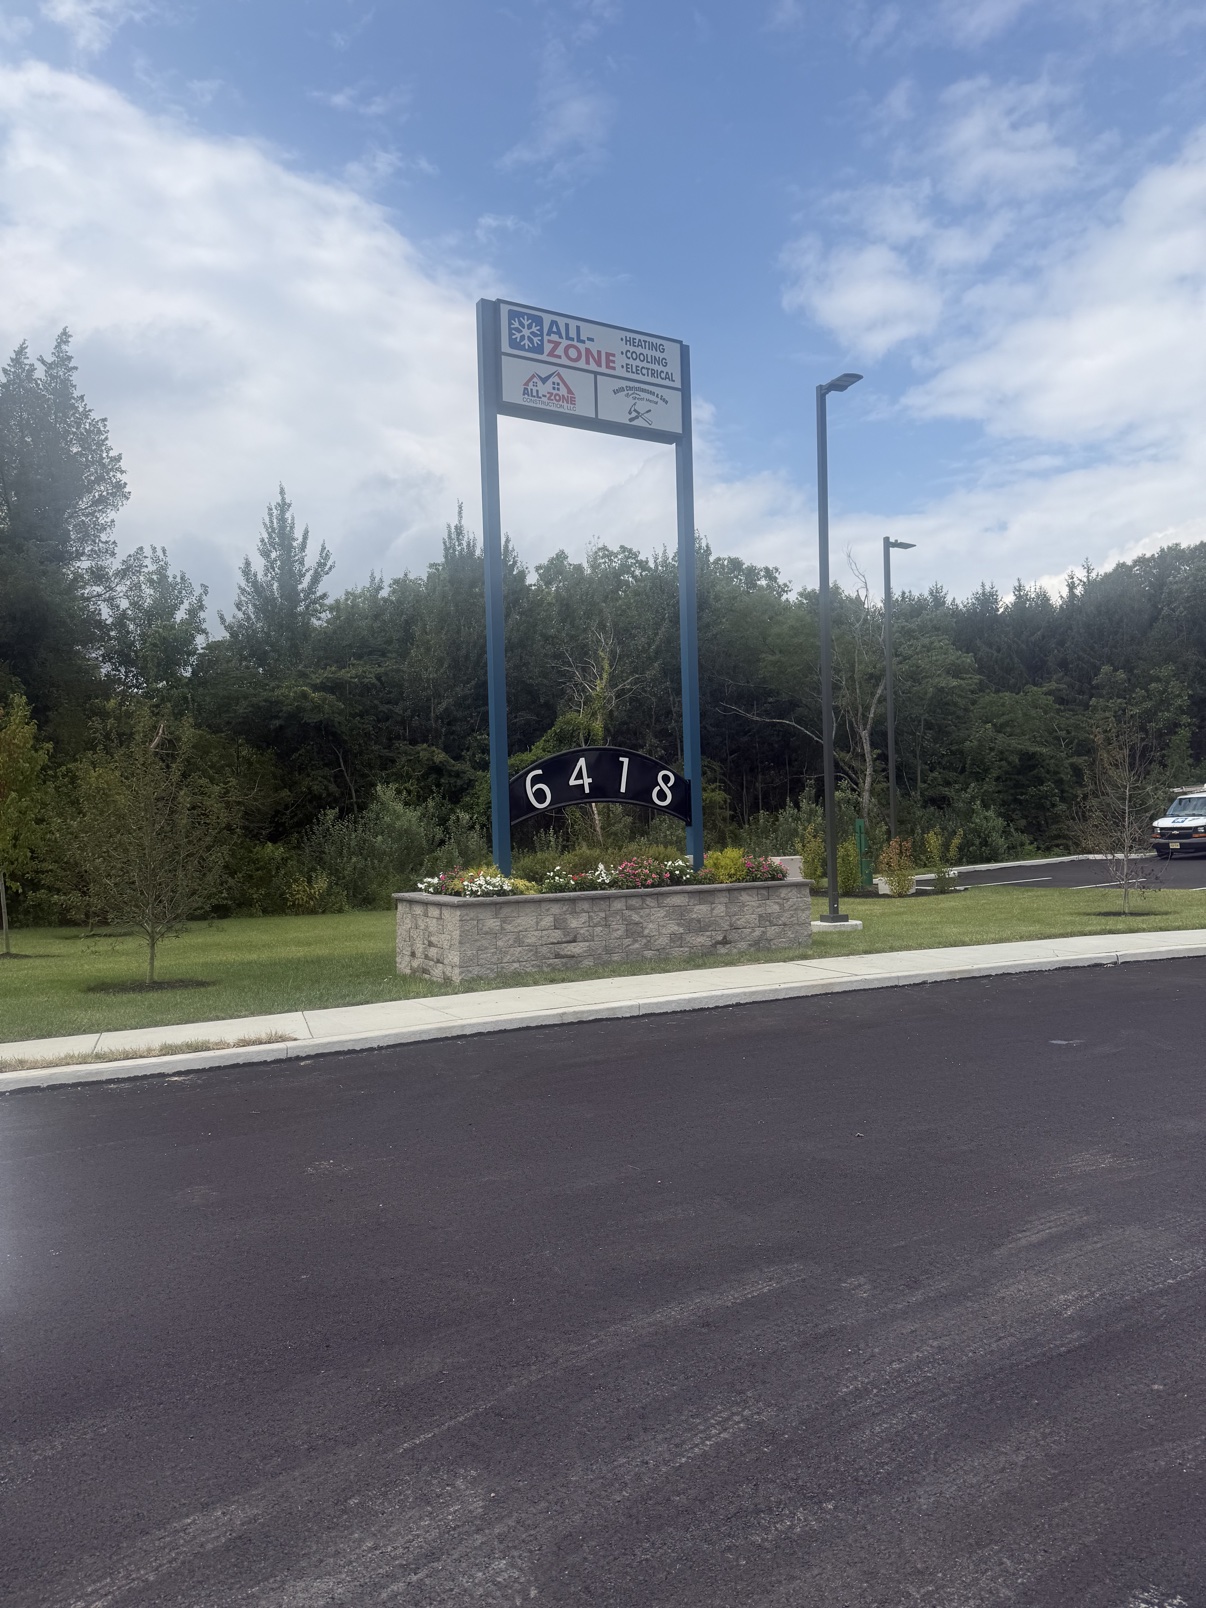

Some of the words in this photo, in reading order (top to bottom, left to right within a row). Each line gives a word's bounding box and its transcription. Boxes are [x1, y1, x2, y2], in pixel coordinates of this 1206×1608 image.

[546, 319, 595, 345] ALL-
[624, 335, 666, 354] HEATING
[546, 339, 617, 371] ZONE
[625, 349, 668, 368] COOLING
[625, 363, 676, 383] ELECTRICAL
[522, 386, 577, 406] ALL-ZONE
[522, 396, 566, 411] CONSTRUCTION,
